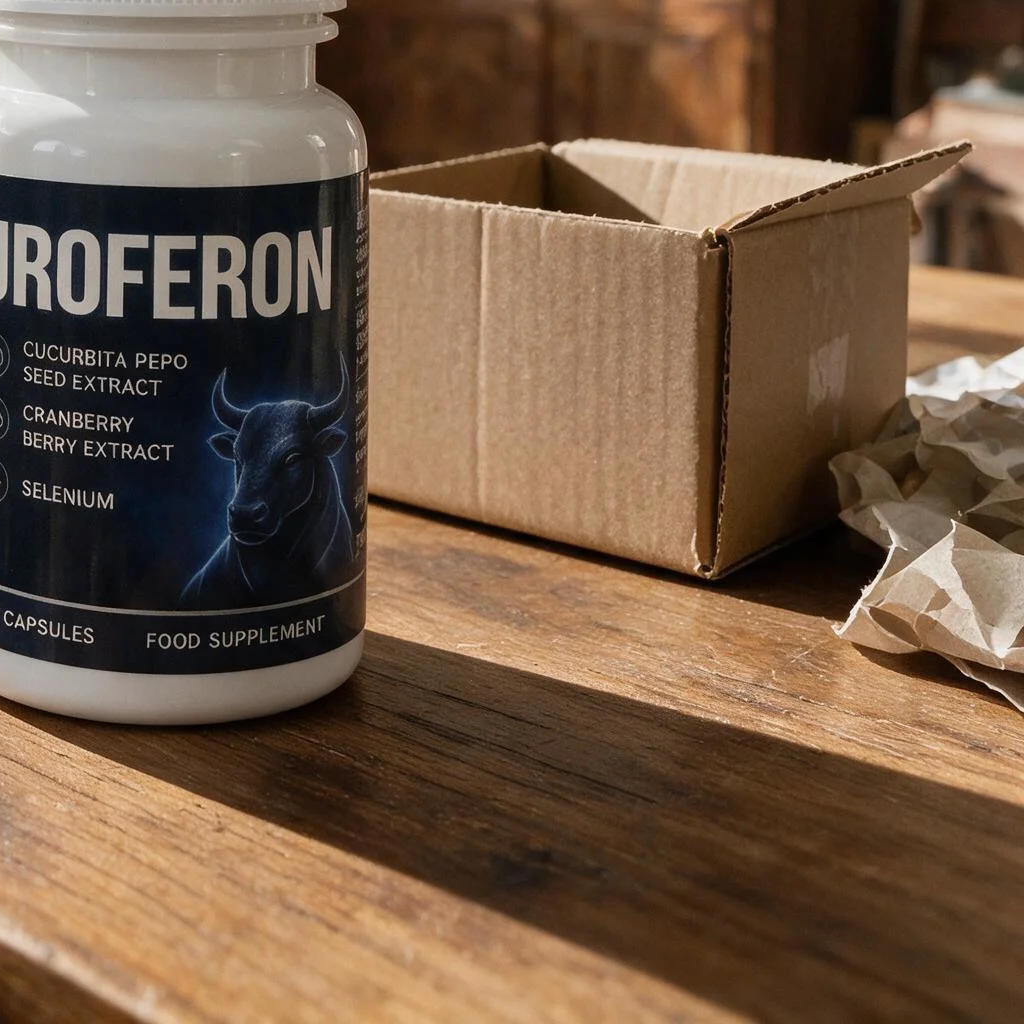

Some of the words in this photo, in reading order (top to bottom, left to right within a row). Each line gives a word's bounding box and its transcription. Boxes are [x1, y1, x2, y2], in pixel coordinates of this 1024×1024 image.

[23, 341, 127, 369] CUCURBITA
[136, 353, 188, 370] PEPO
[23, 366, 66, 387] SEED
[73, 375, 163, 396] EXTRACT
[23, 405, 134, 433] CRANBERRY
[23, 430, 77, 454] BERRY
[83, 441, 175, 461] EXTRACT
[22, 479, 114, 510] SELENIUM
[3, 610, 95, 644] CAPSULES
[147, 632, 201, 649] FOOD
[209, 614, 325, 649] SUPPLEMENT
